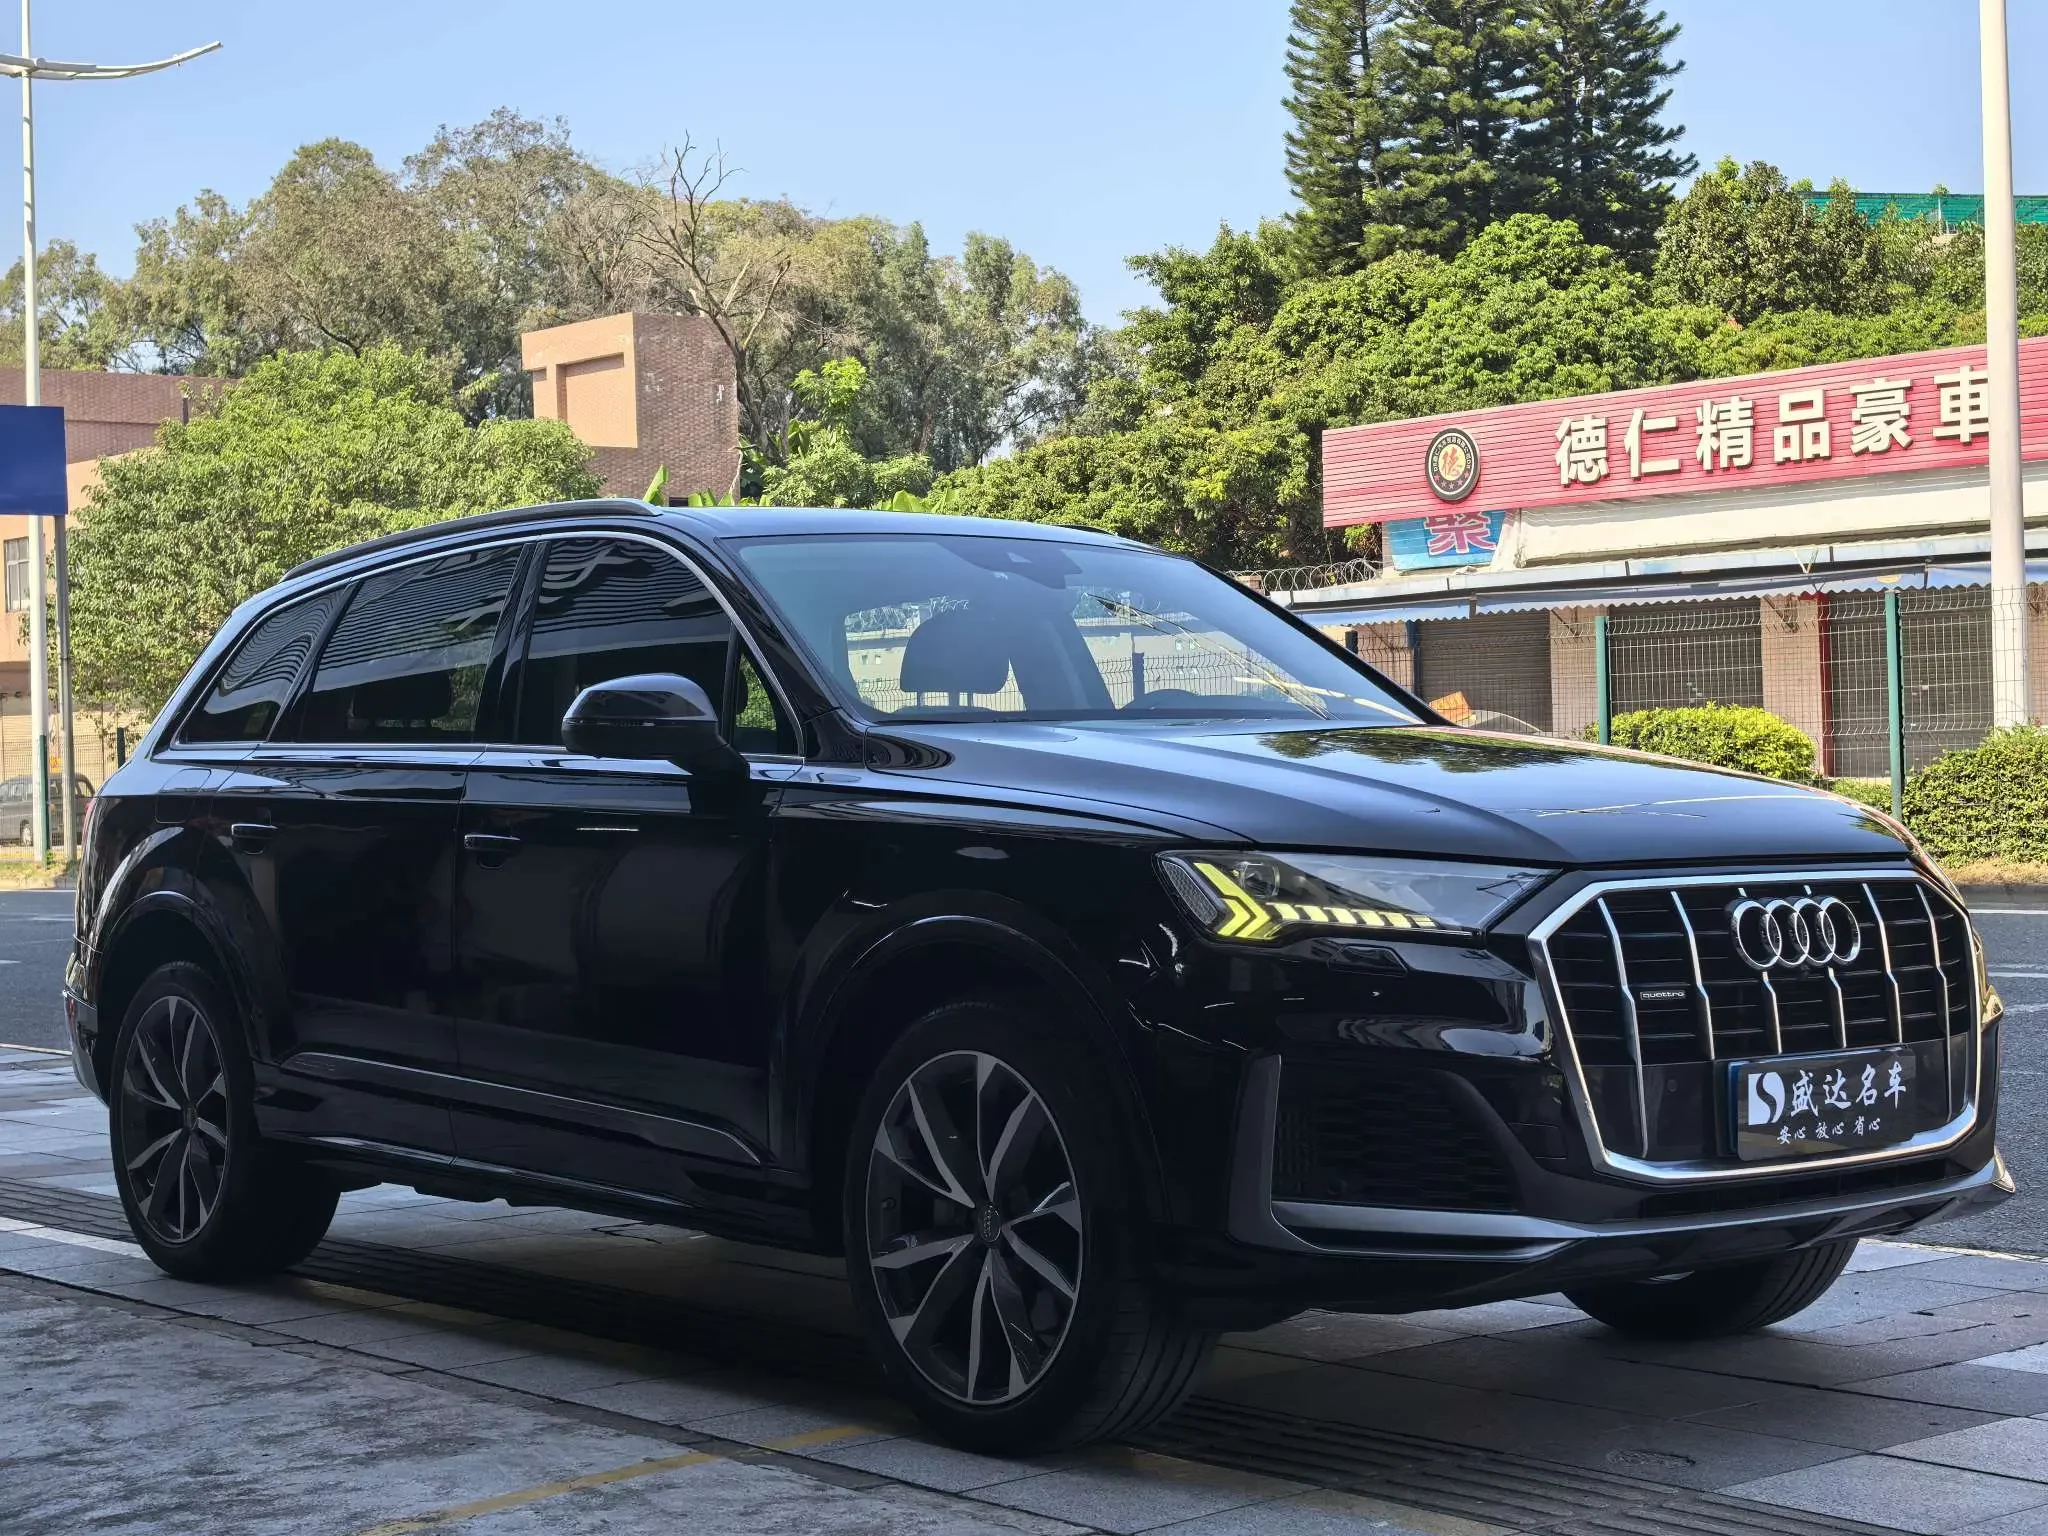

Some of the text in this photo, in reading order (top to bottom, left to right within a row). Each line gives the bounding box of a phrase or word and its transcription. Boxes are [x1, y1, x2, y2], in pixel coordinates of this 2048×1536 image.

[1555, 365, 1989, 487] 德仁精品豪車
[1791, 1061, 1906, 1117] 盛达名车
[1777, 1116, 1881, 1145] 安心 放心 省心
